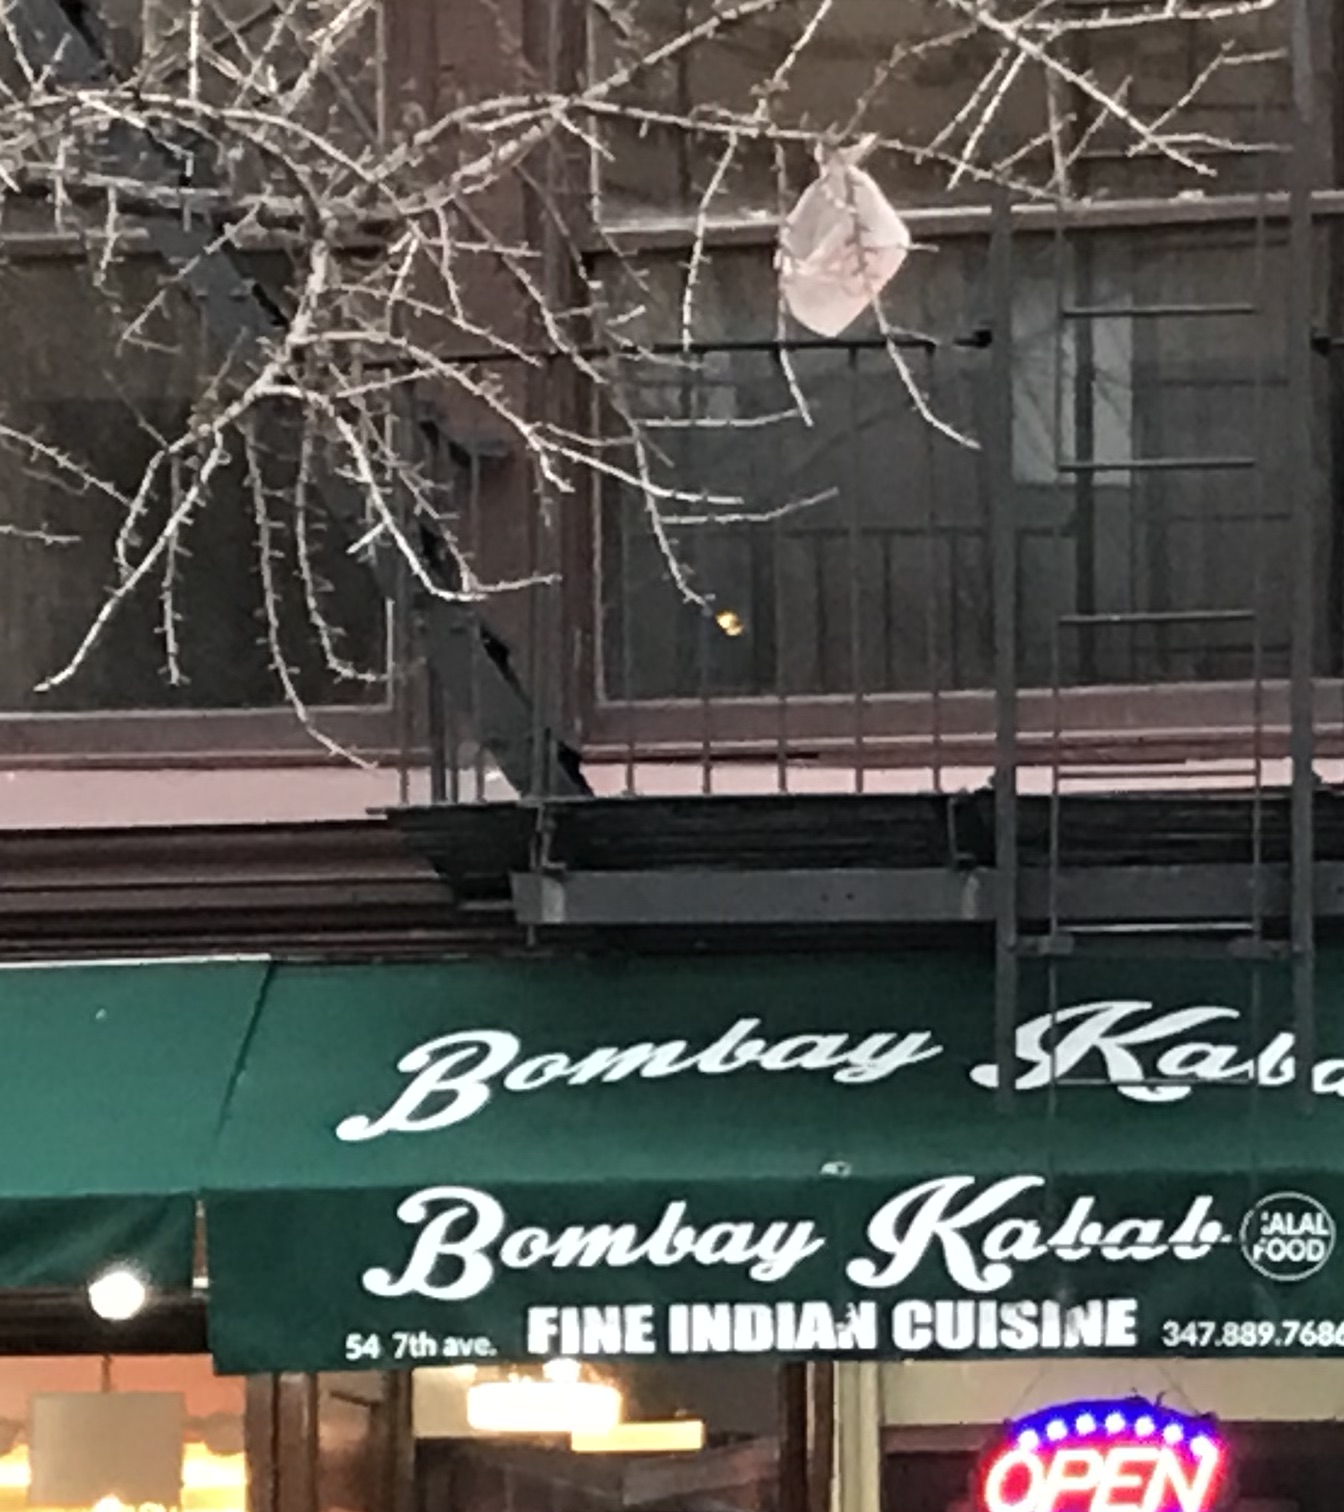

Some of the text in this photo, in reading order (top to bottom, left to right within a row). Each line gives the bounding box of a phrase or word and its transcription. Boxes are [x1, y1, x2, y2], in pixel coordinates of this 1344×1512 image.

[336, 1017, 944, 1142] Bombay
[361, 1175, 1232, 1301] Bombay Kabab
[345, 1330, 498, 1361] 54 7th ave.
[527, 1299, 1137, 1355] FINE INDIAN CUISINE
